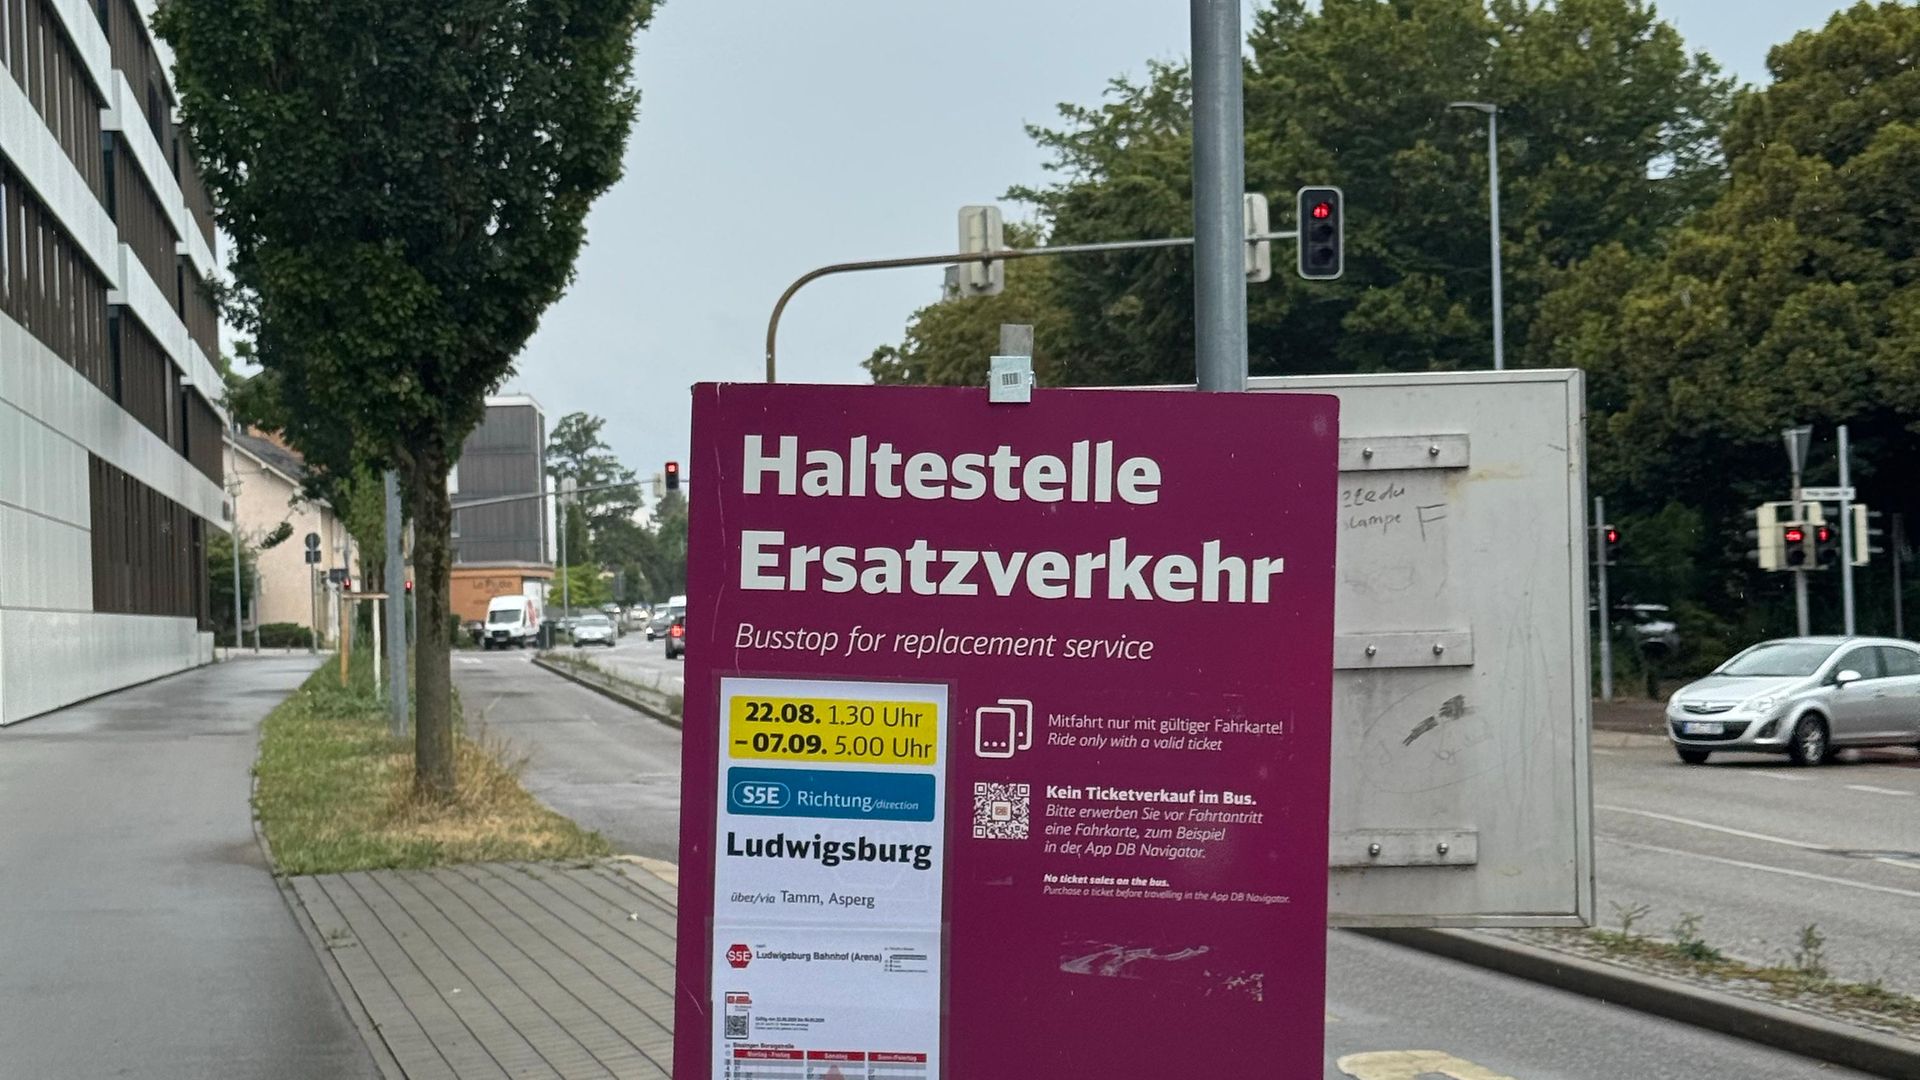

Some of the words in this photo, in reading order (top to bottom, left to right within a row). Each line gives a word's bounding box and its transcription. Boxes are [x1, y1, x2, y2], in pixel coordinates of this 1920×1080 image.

[742, 434, 1162, 505] Haltestelle
[740, 530, 1284, 604] Ersatzverkehr
[735, 622, 839, 657] Busstop
[846, 625, 886, 658] for
[892, 627, 1055, 663] replacement
[1062, 633, 1154, 661] service
[745, 702, 821, 724] 22.08.
[828, 705, 875, 726] 1.30
[883, 707, 923, 728] Uhr
[1048, 714, 1103, 728] Mitfahrt
[1108, 718, 1130, 729] nur
[1134, 717, 1156, 730] mit
[1159, 718, 1210, 733] gültiger
[1215, 719, 1283, 734] Fahrkarte!
[752, 732, 828, 755] 07.09.
[834, 736, 884, 757] 5.00
[892, 738, 933, 759] Uhr
[1047, 732, 1076, 746] Ride
[1079, 734, 1107, 749] only
[1110, 735, 1137, 748] with
[1141, 739, 1150, 748] a
[1154, 735, 1183, 750] valid
[1187, 737, 1222, 751] ticket
[742, 785, 780, 805] S5E
[1046, 785, 1082, 800] Kein
[1085, 786, 1196, 803] Ticketverkauf
[1199, 790, 1218, 804] im
[1223, 791, 1257, 805] Bus.
[1045, 804, 1076, 818] Bitte
[1079, 806, 1138, 820] erwerben
[1141, 807, 1161, 820] Sie
[1164, 810, 1184, 821] vor
[1188, 809, 1264, 824] Fahrtantritt
[1045, 823, 1072, 836] eine
[1074, 823, 1140, 839] Fahrkarte,
[1144, 827, 1172, 839] zum
[1176, 826, 1226, 843] Beispiel
[727, 831, 932, 871] Ludwigsburg
[1044, 840, 1057, 853] in
[1060, 841, 1081, 854] der
[1084, 842, 1112, 857] App
[1115, 843, 1136, 855] DB
[1139, 844, 1206, 860] Navigator.
[1043, 874, 1058, 883] No
[1059, 874, 1089, 884] ticket
[1089, 875, 1115, 885] sales
[1131, 876, 1148, 886] the
[1149, 877, 1170, 887] bus.
[780, 890, 824, 906] Tamm,
[828, 892, 875, 909] Asperg
[1043, 885, 1082, 896] Purchase
[1091, 887, 1114, 897] ticket
[1115, 888, 1143, 898] before
[1184, 890, 1193, 900] in
[1194, 890, 1209, 900] the
[1210, 891, 1229, 902] App
[1230, 892, 1245, 902] DB
[727, 951, 750, 962] S5E
[756, 950, 811, 962] Ludwigsburg
[813, 951, 849, 961] Bahnhof
[850, 952, 882, 963] (Arena)
